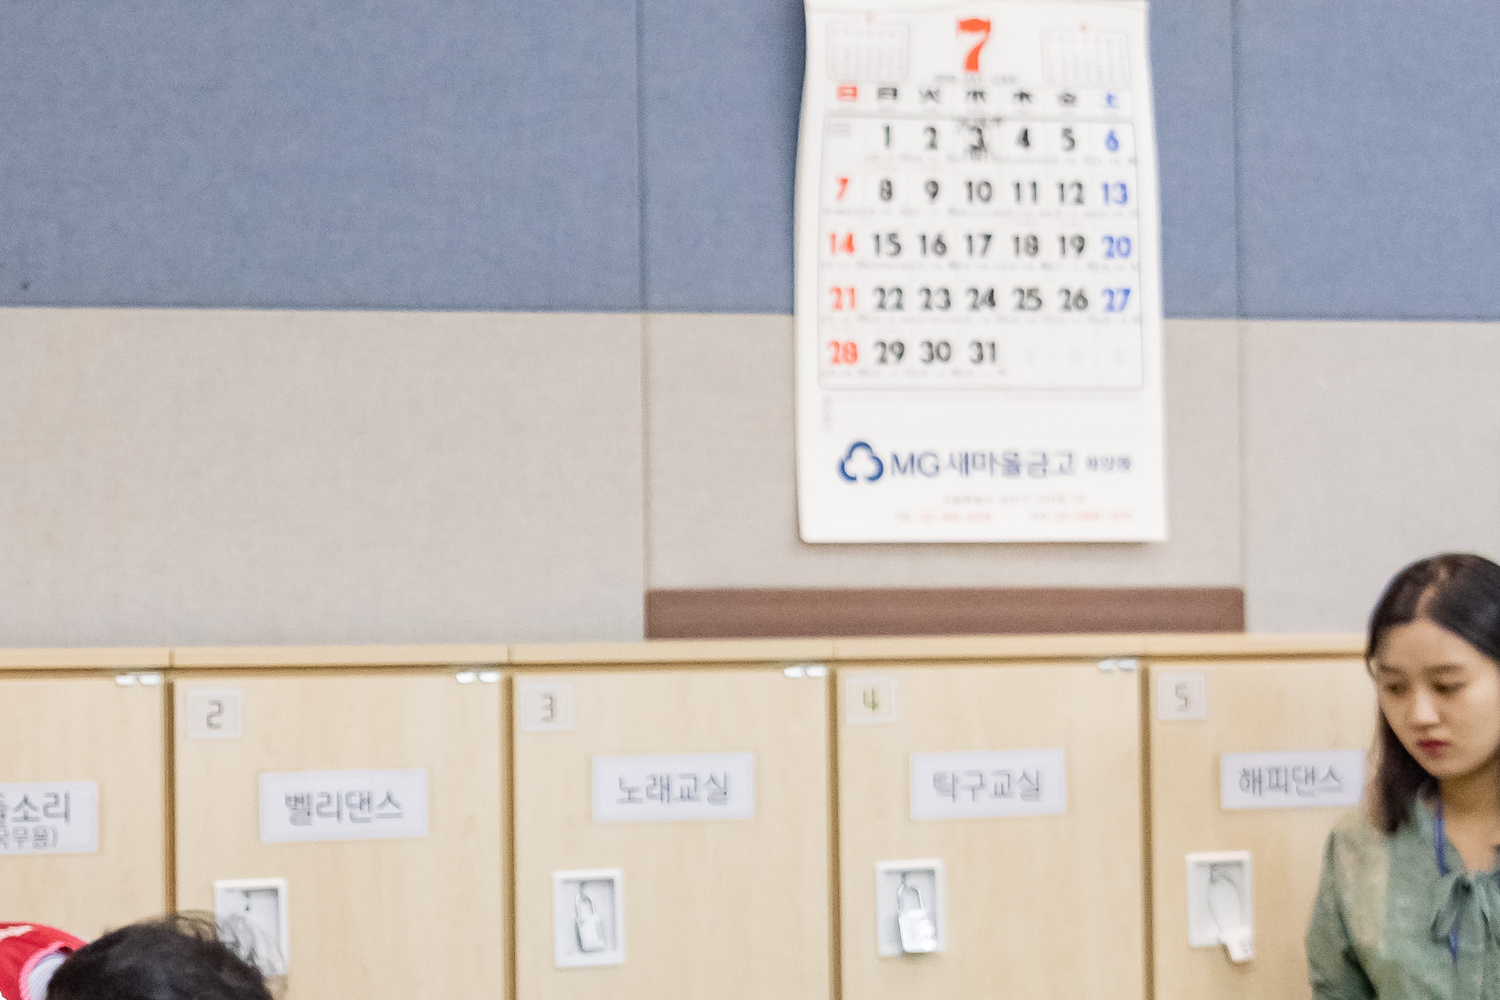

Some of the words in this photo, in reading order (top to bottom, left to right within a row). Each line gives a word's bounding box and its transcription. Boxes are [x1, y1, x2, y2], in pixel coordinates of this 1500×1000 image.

[957, 18, 992, 73] 7
[881, 123, 894, 150] 1
[922, 123, 940, 152] 2
[1016, 125, 1032, 151] 4
[1061, 127, 1076, 151] 5
[1105, 129, 1120, 152] 6
[836, 176, 850, 201] 7
[879, 179, 894, 202] 8
[924, 179, 940, 202] 9
[965, 180, 993, 203] 10
[1014, 180, 1038, 203] 11
[1057, 181, 1086, 206] 12
[1102, 182, 1129, 205] 13
[829, 232, 856, 255] 14
[873, 232, 902, 257] 15
[919, 233, 948, 257] 16
[965, 233, 993, 256] 17
[1013, 234, 1040, 257] 18
[1059, 234, 1086, 256] 19
[1103, 235, 1132, 259] 20
[831, 286, 856, 311] 21
[875, 286, 904, 311] 22
[919, 286, 952, 311] 23
[967, 287, 997, 311] 24
[1014, 287, 1043, 311] 25
[1059, 288, 1089, 311] 26
[1103, 287, 1131, 313] 27
[829, 340, 859, 365] 28
[875, 340, 906, 365] 29
[919, 340, 952, 365] 30
[968, 340, 998, 366] 31
[540, 694, 555, 721] 3
[861, 687, 879, 714] 4
[1175, 682, 1191, 712] 5
[205, 699, 224, 730] 2
[616, 771, 731, 807] 노래교실
[932, 769, 1042, 803] 탁구교실
[283, 789, 404, 824] 벨리댄스
